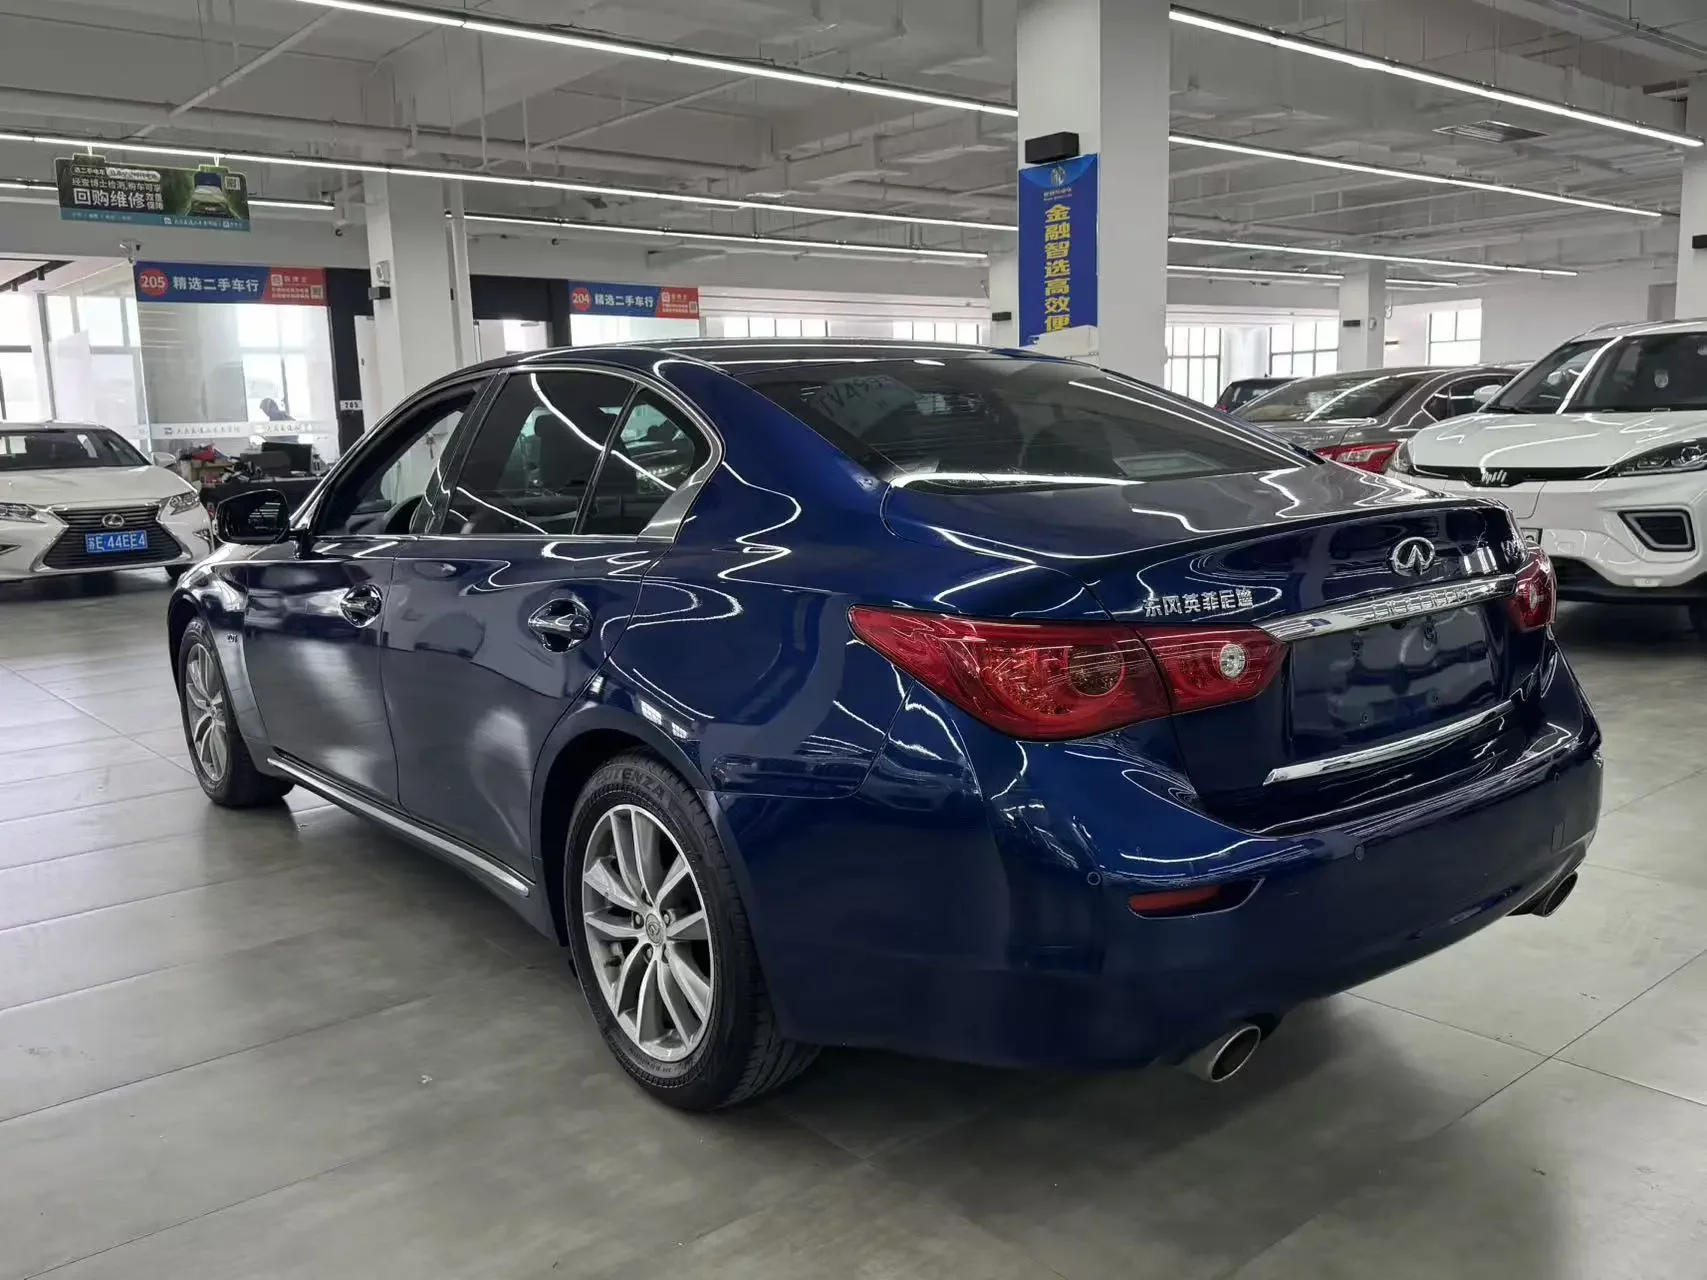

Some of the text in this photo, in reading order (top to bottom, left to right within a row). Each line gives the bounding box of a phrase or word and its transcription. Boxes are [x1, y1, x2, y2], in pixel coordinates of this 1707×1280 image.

[73, 187, 145, 208] 回购维修
[1044, 203, 1071, 333] 金融智选高效便
[140, 275, 260, 292] 205 精选二手车行
[572, 292, 589, 304] 204
[594, 292, 654, 308] 精选二手车行
